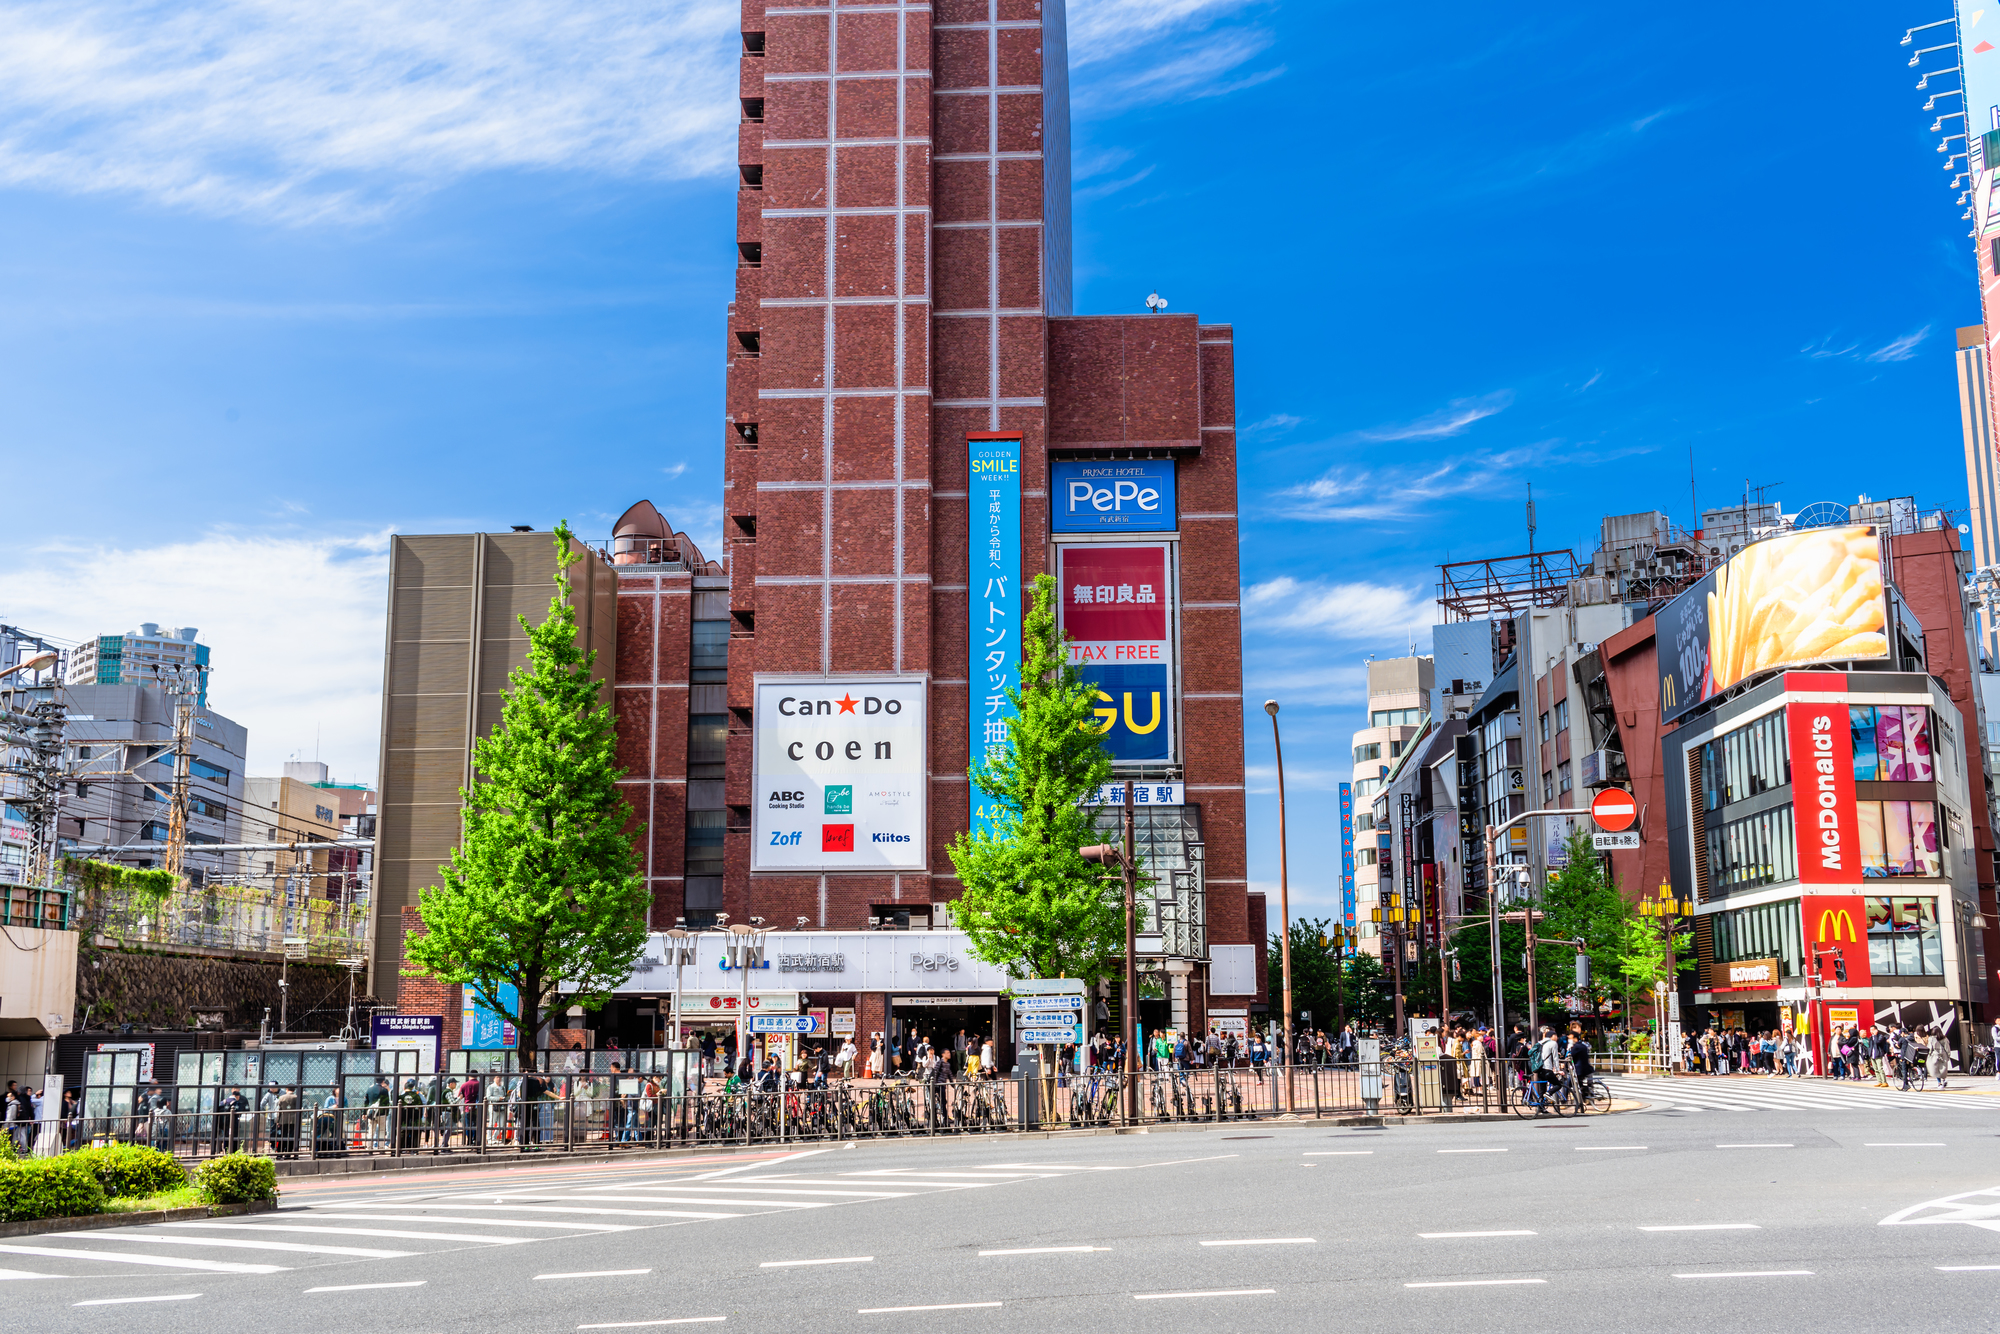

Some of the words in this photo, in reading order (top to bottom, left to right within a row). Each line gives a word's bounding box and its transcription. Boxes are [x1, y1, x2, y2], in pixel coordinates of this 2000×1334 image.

[972, 459, 1018, 473] SMILE
[1082, 468, 1114, 477] PRINCE
[1115, 467, 1146, 476] HOTEL
[1069, 480, 1160, 512] PePe
[1099, 515, 1129, 523] 西武新宿
[988, 489, 1001, 569] 平成から令和へ
[1073, 583, 1156, 604] 無印良品
[1071, 645, 1107, 660] TAX
[1115, 645, 1160, 660] FREE
[1679, 636, 1709, 693] 100%
[778, 696, 832, 717] Can
[864, 696, 902, 716] Do
[1071, 689, 1161, 735] GU
[787, 740, 892, 761] coen
[769, 791, 805, 802] ABC
[1071, 786, 1174, 804] 武新宿駅
[1812, 715, 1843, 870] McDonald's
[975, 804, 1008, 819] 4.27
[770, 831, 803, 846] Zoff
[872, 832, 911, 843] Kiitos
[1595, 835, 1639, 847] 自転車を除く
[777, 953, 845, 967] 西武新宿駅
[909, 952, 959, 972] PePe
[1729, 964, 1771, 982] McDonald's
[757, 1018, 792, 1026] 靖国通り
[797, 1020, 808, 1028] 302
